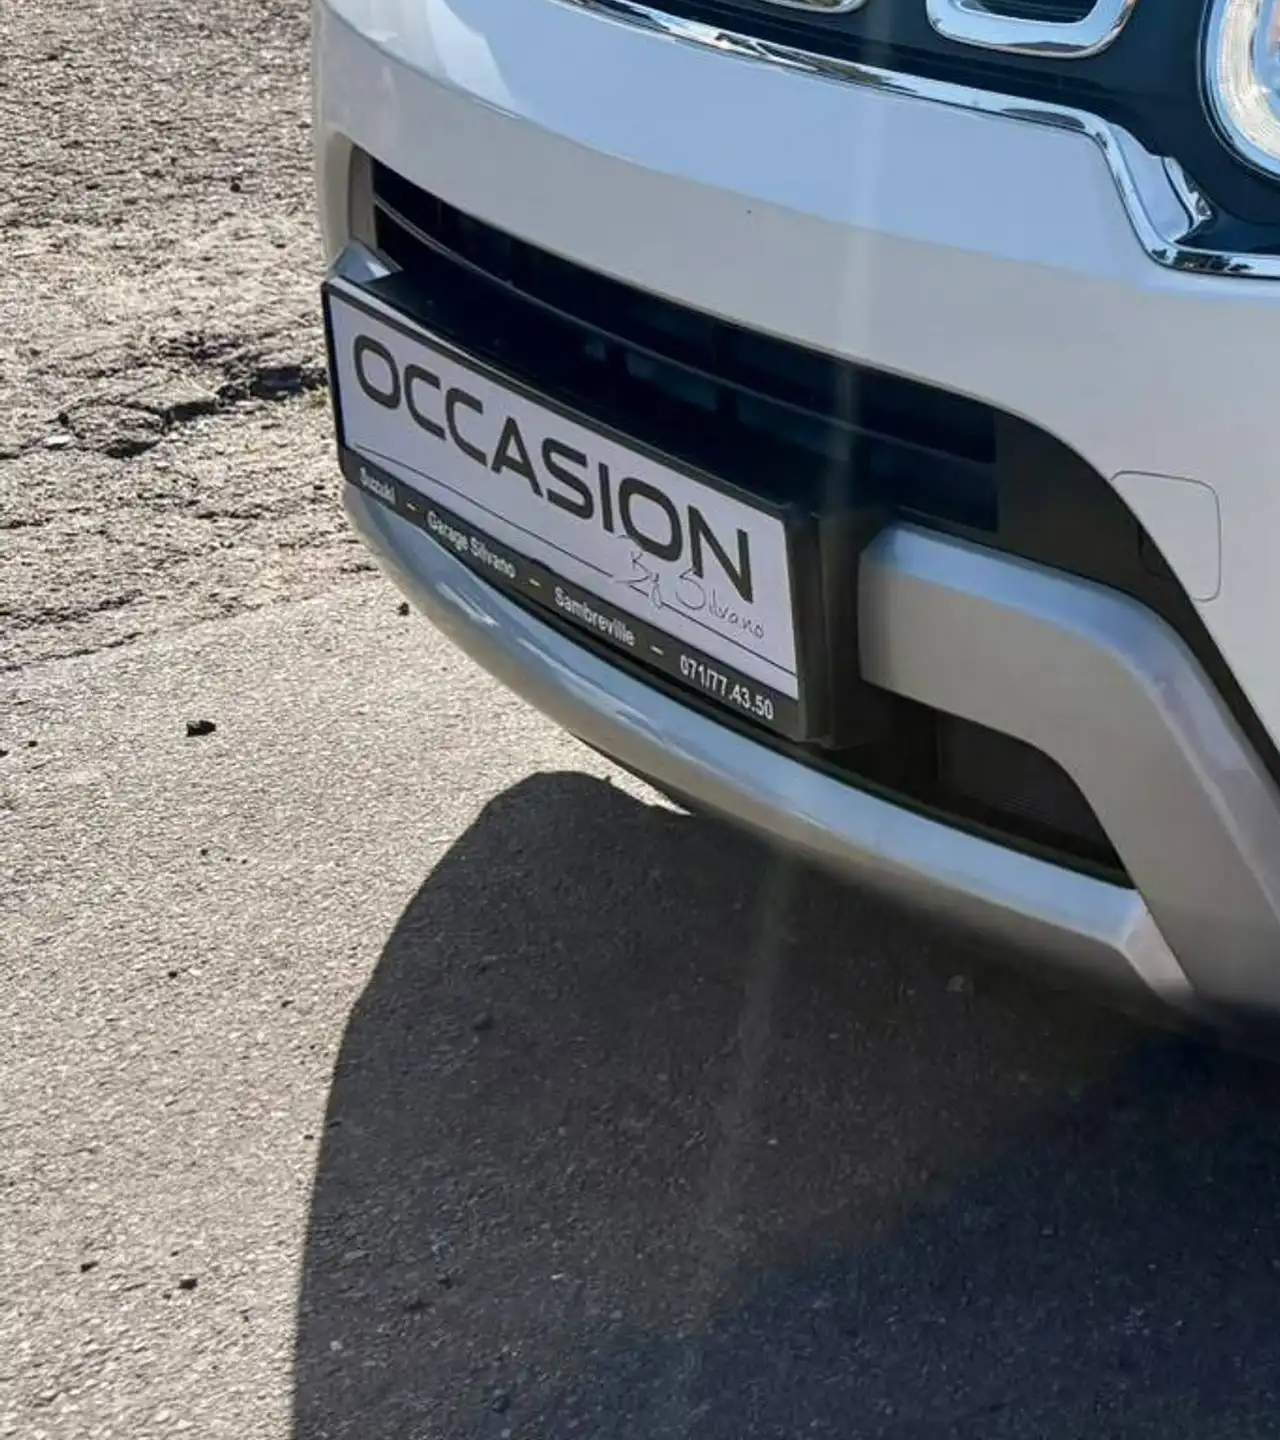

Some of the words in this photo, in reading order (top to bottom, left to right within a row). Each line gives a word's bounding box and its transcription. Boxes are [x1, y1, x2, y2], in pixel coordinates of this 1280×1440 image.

[353, 334, 754, 604] OCCASION
[426, 510, 470, 553] Garage
[469, 536, 517, 580] Silvano
[554, 587, 636, 647] Sambreville
[680, 655, 774, 720] 071/77.43.50
